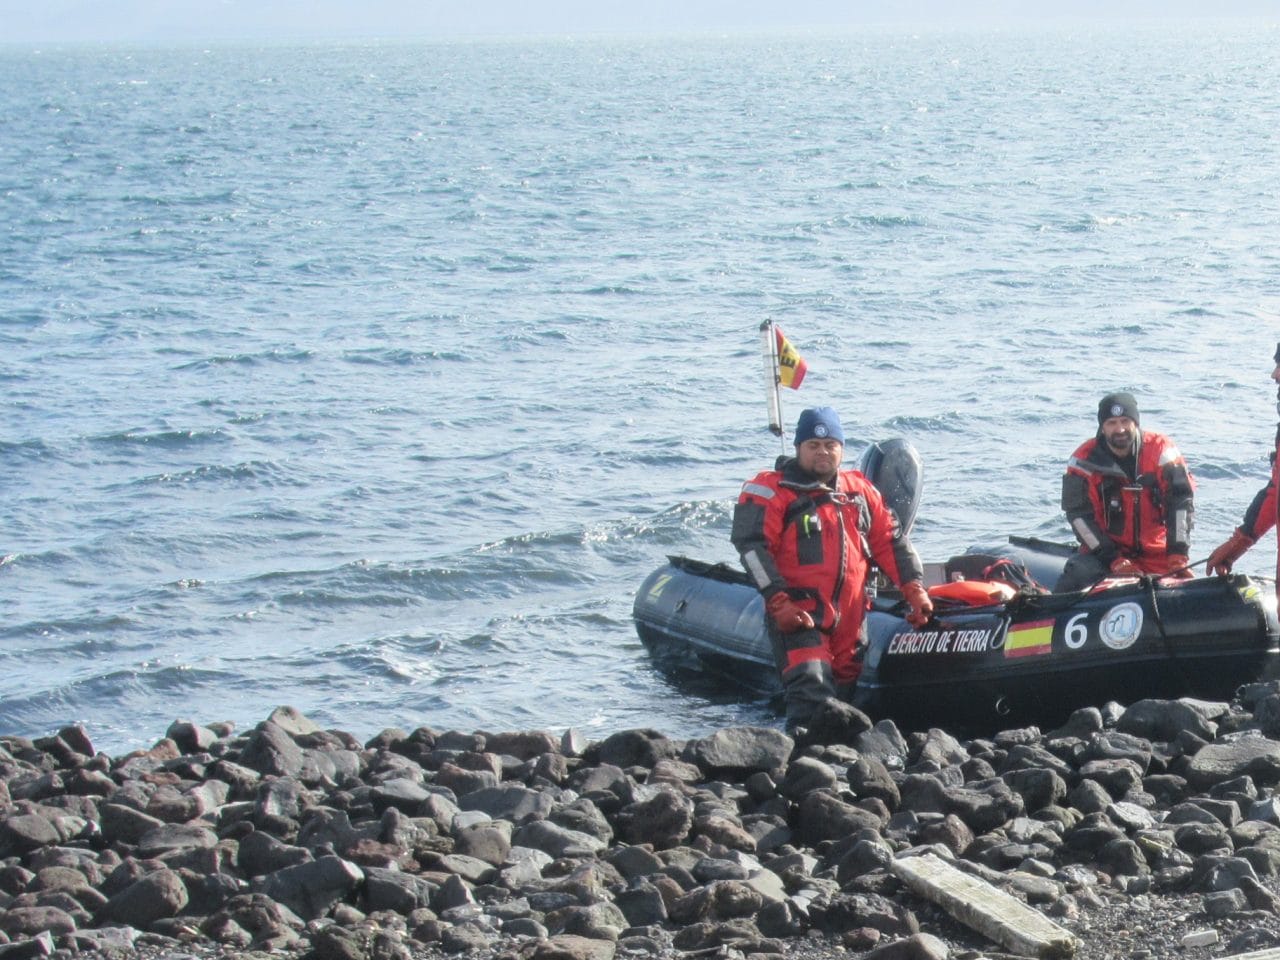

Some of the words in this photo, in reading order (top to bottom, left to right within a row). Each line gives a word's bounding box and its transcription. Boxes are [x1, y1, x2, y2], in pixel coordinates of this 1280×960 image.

[936, 630, 956, 653] DE
[953, 628, 992, 652] TIERRA
[1065, 612, 1089, 649] 6
